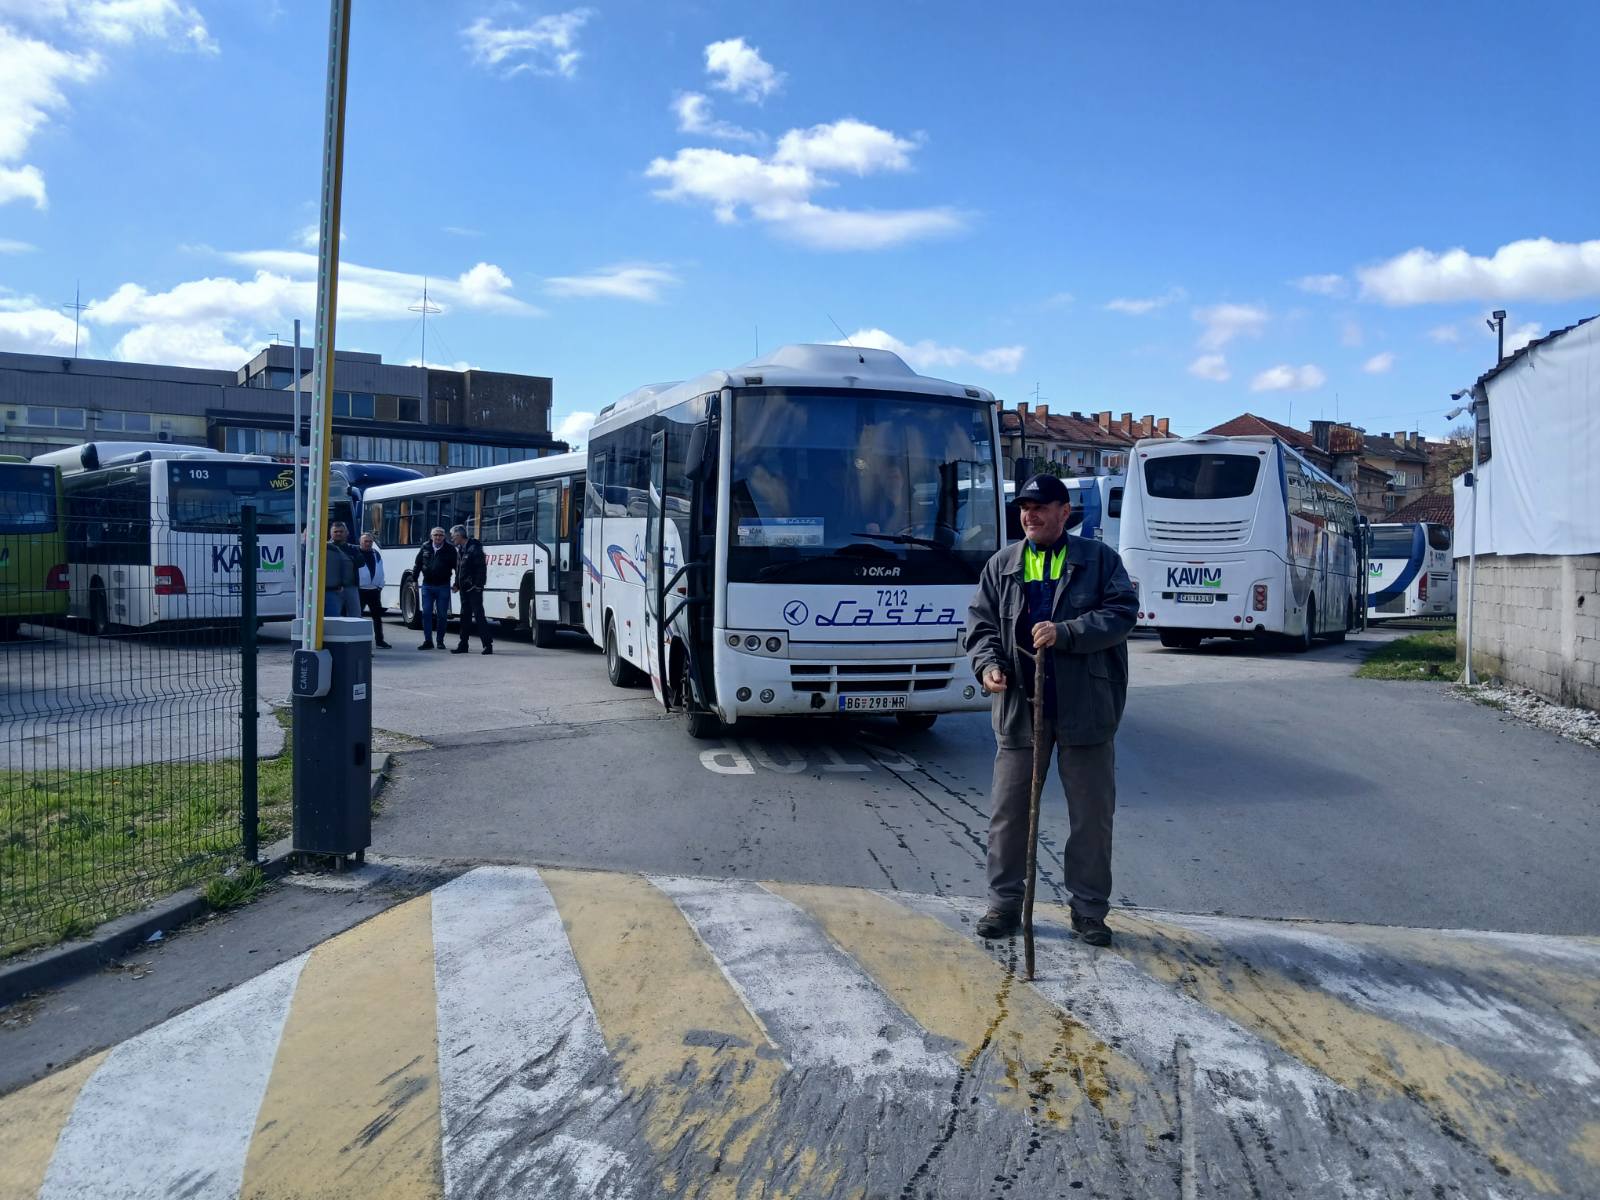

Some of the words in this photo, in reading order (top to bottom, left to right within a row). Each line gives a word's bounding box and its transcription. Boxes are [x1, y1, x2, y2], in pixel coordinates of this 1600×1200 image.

[189, 469, 209, 480] 103
[269, 479, 289, 489] VWG
[212, 545, 284, 573] KAIM
[1167, 567, 1222, 588] KAVIM
[876, 590, 908, 606] 7212
[815, 601, 965, 626] Lasta
[847, 698, 860, 709] BG
